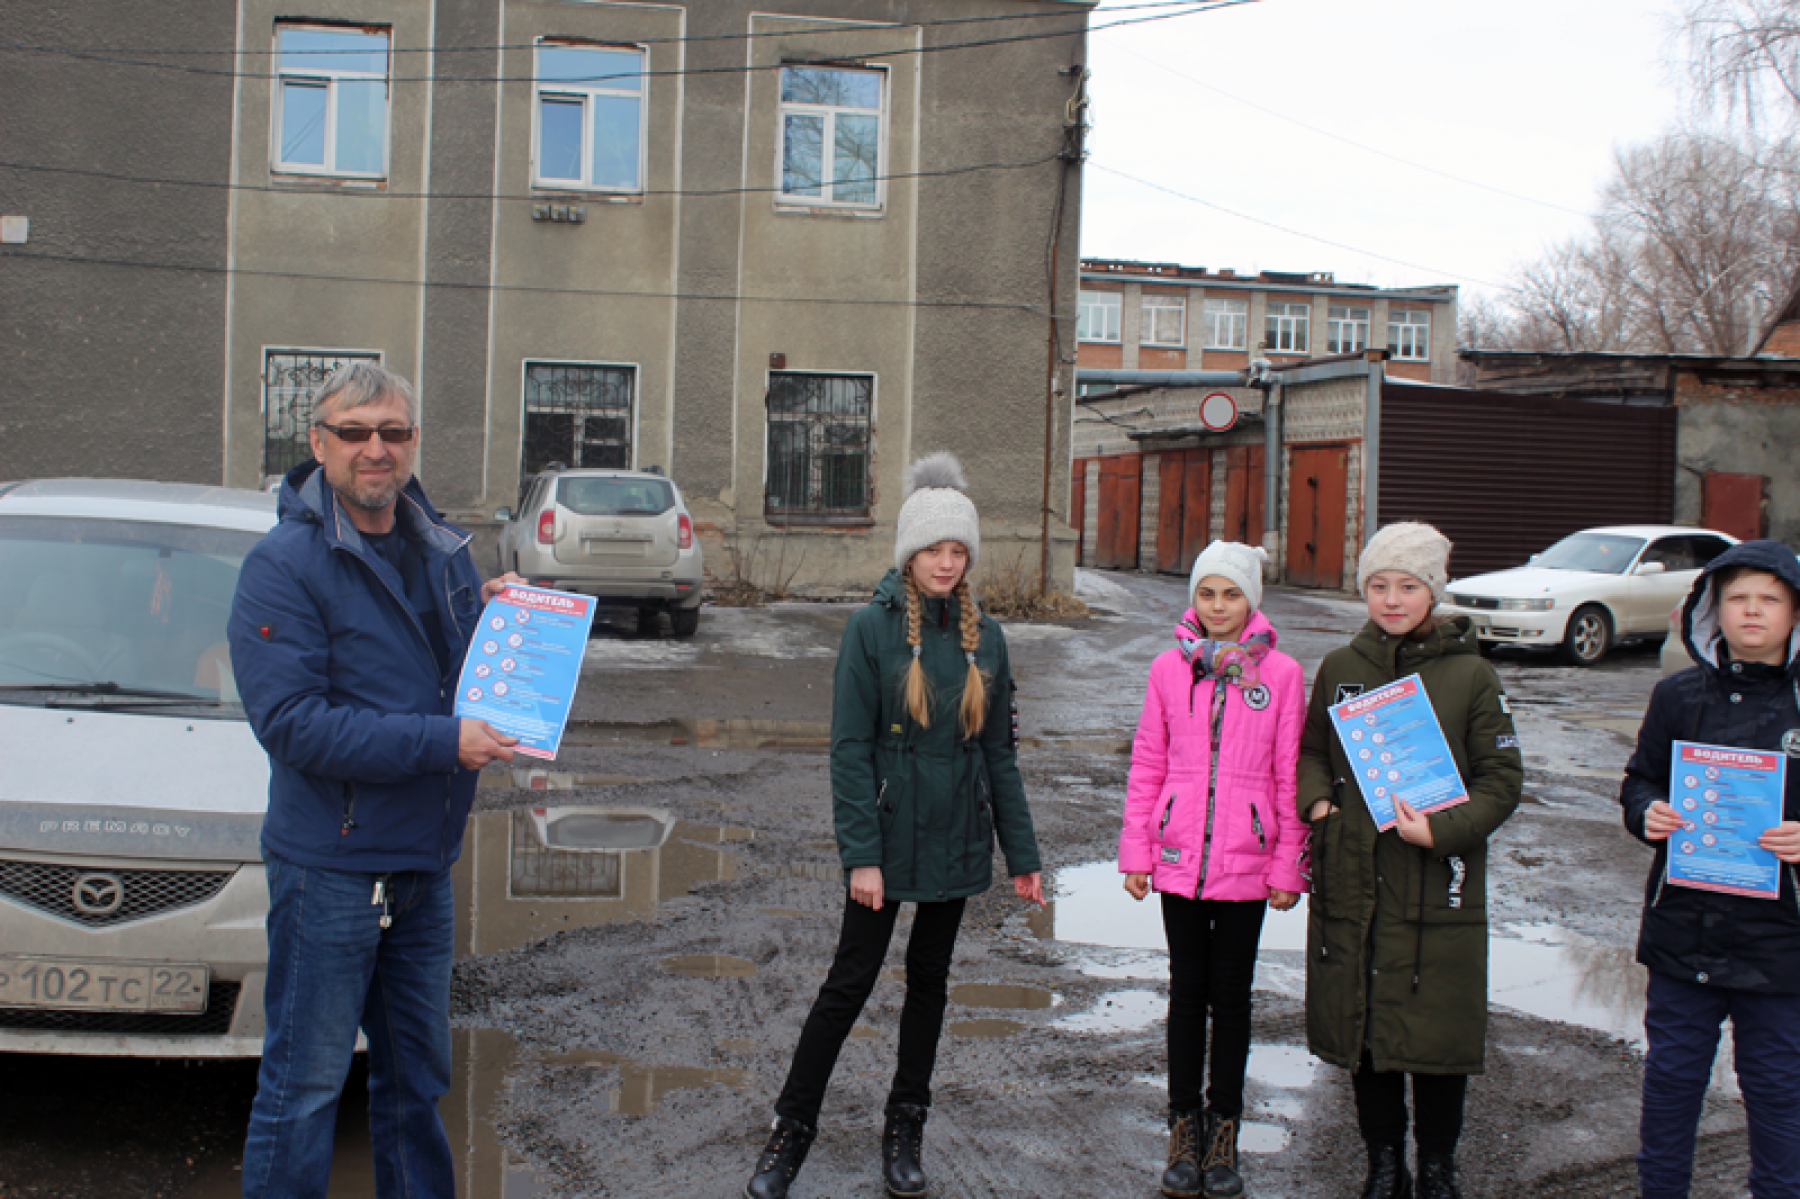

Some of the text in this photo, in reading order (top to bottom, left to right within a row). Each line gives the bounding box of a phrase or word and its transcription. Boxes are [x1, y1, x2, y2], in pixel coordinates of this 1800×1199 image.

[508, 589, 575, 608] ВОДИТЕЛЬ
[1693, 748, 1763, 763] ВОДИТЕЛЬ
[39, 820, 191, 837] PREMACY
[155, 971, 192, 996] 22
